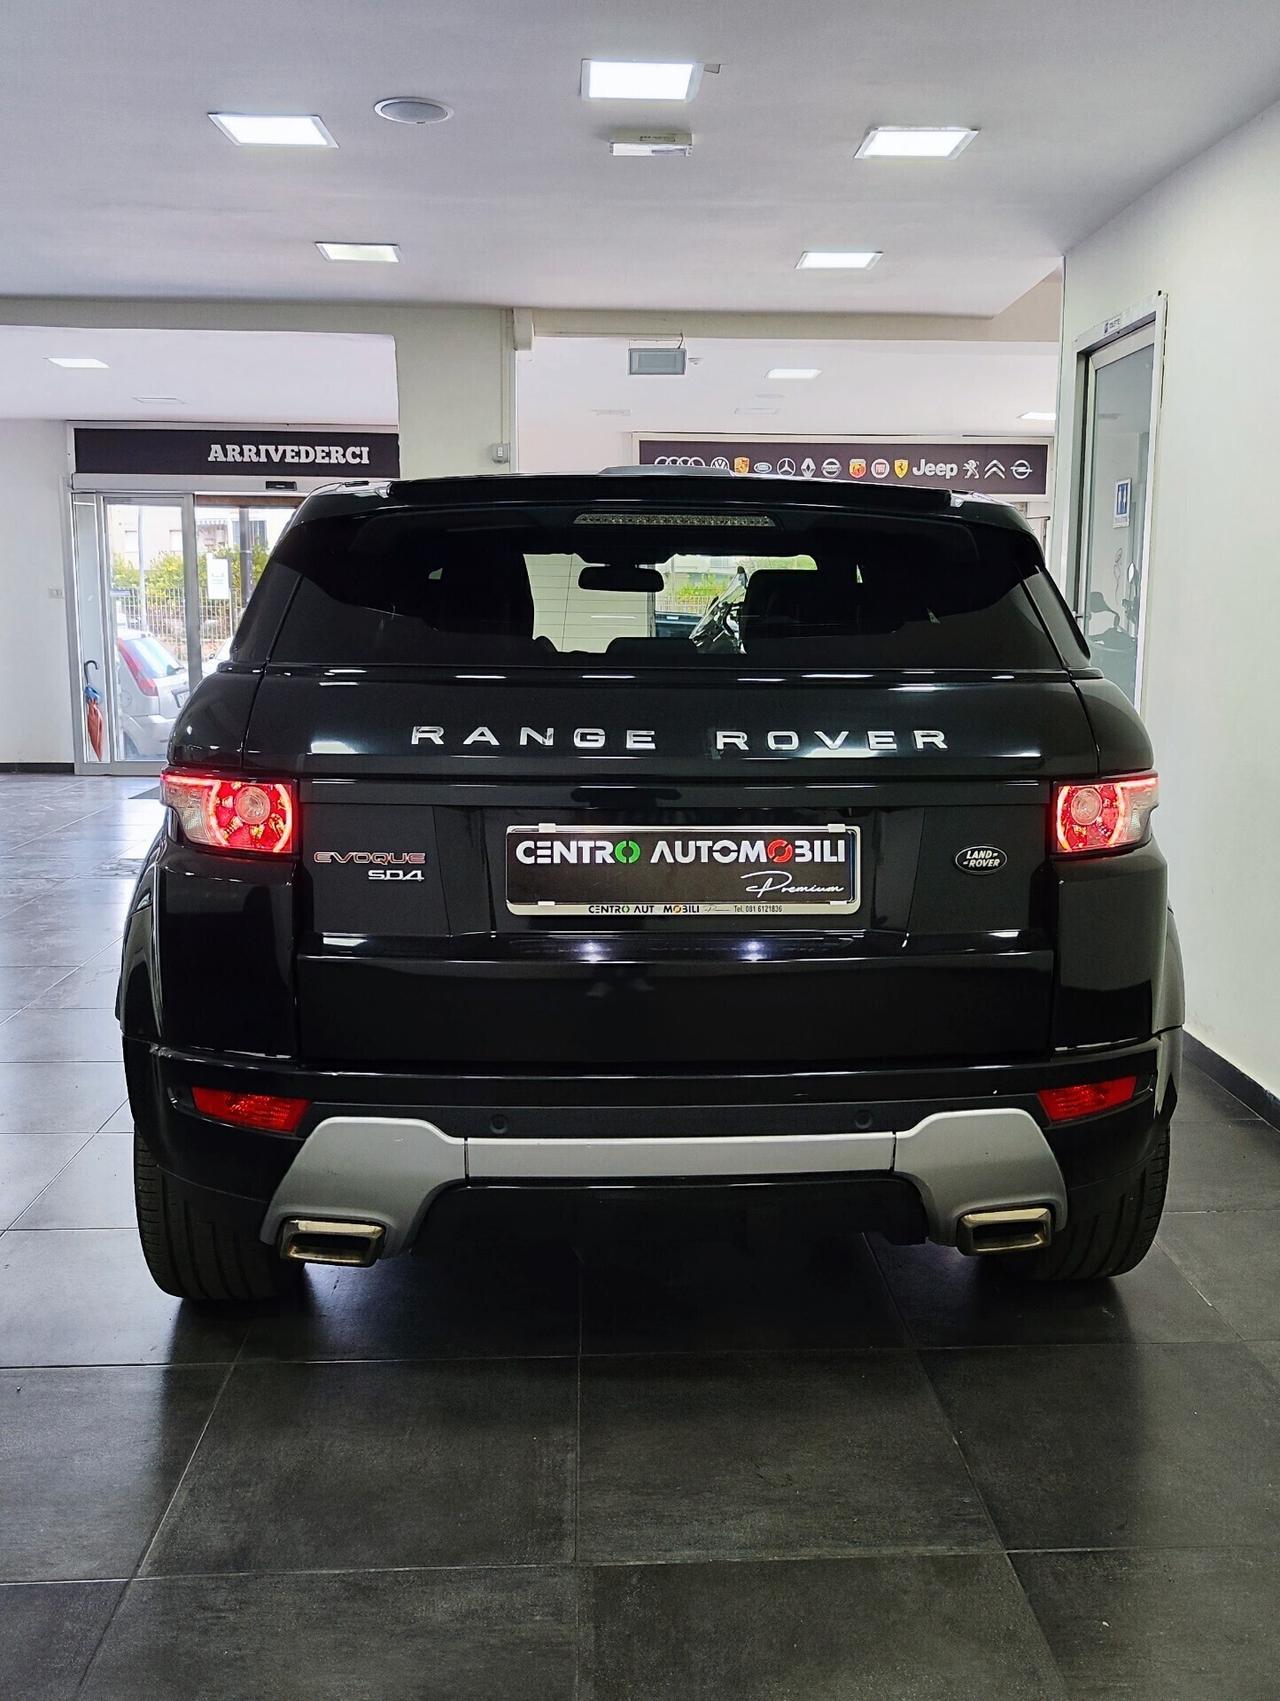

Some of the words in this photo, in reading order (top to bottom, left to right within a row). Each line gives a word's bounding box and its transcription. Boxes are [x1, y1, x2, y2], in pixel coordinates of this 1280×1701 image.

[208, 444, 370, 464] ARRIVEDERCI
[912, 458, 959, 480] Jeep
[410, 725, 657, 750] RANGE
[715, 730, 948, 751] ROVER
[313, 851, 426, 866] EVOQUE
[515, 839, 641, 865] CENTRO
[650, 838, 846, 864] AUTOMOBILI
[367, 869, 425, 881] SD4
[739, 870, 845, 899] Premium
[588, 905, 630, 914] CENTRO
